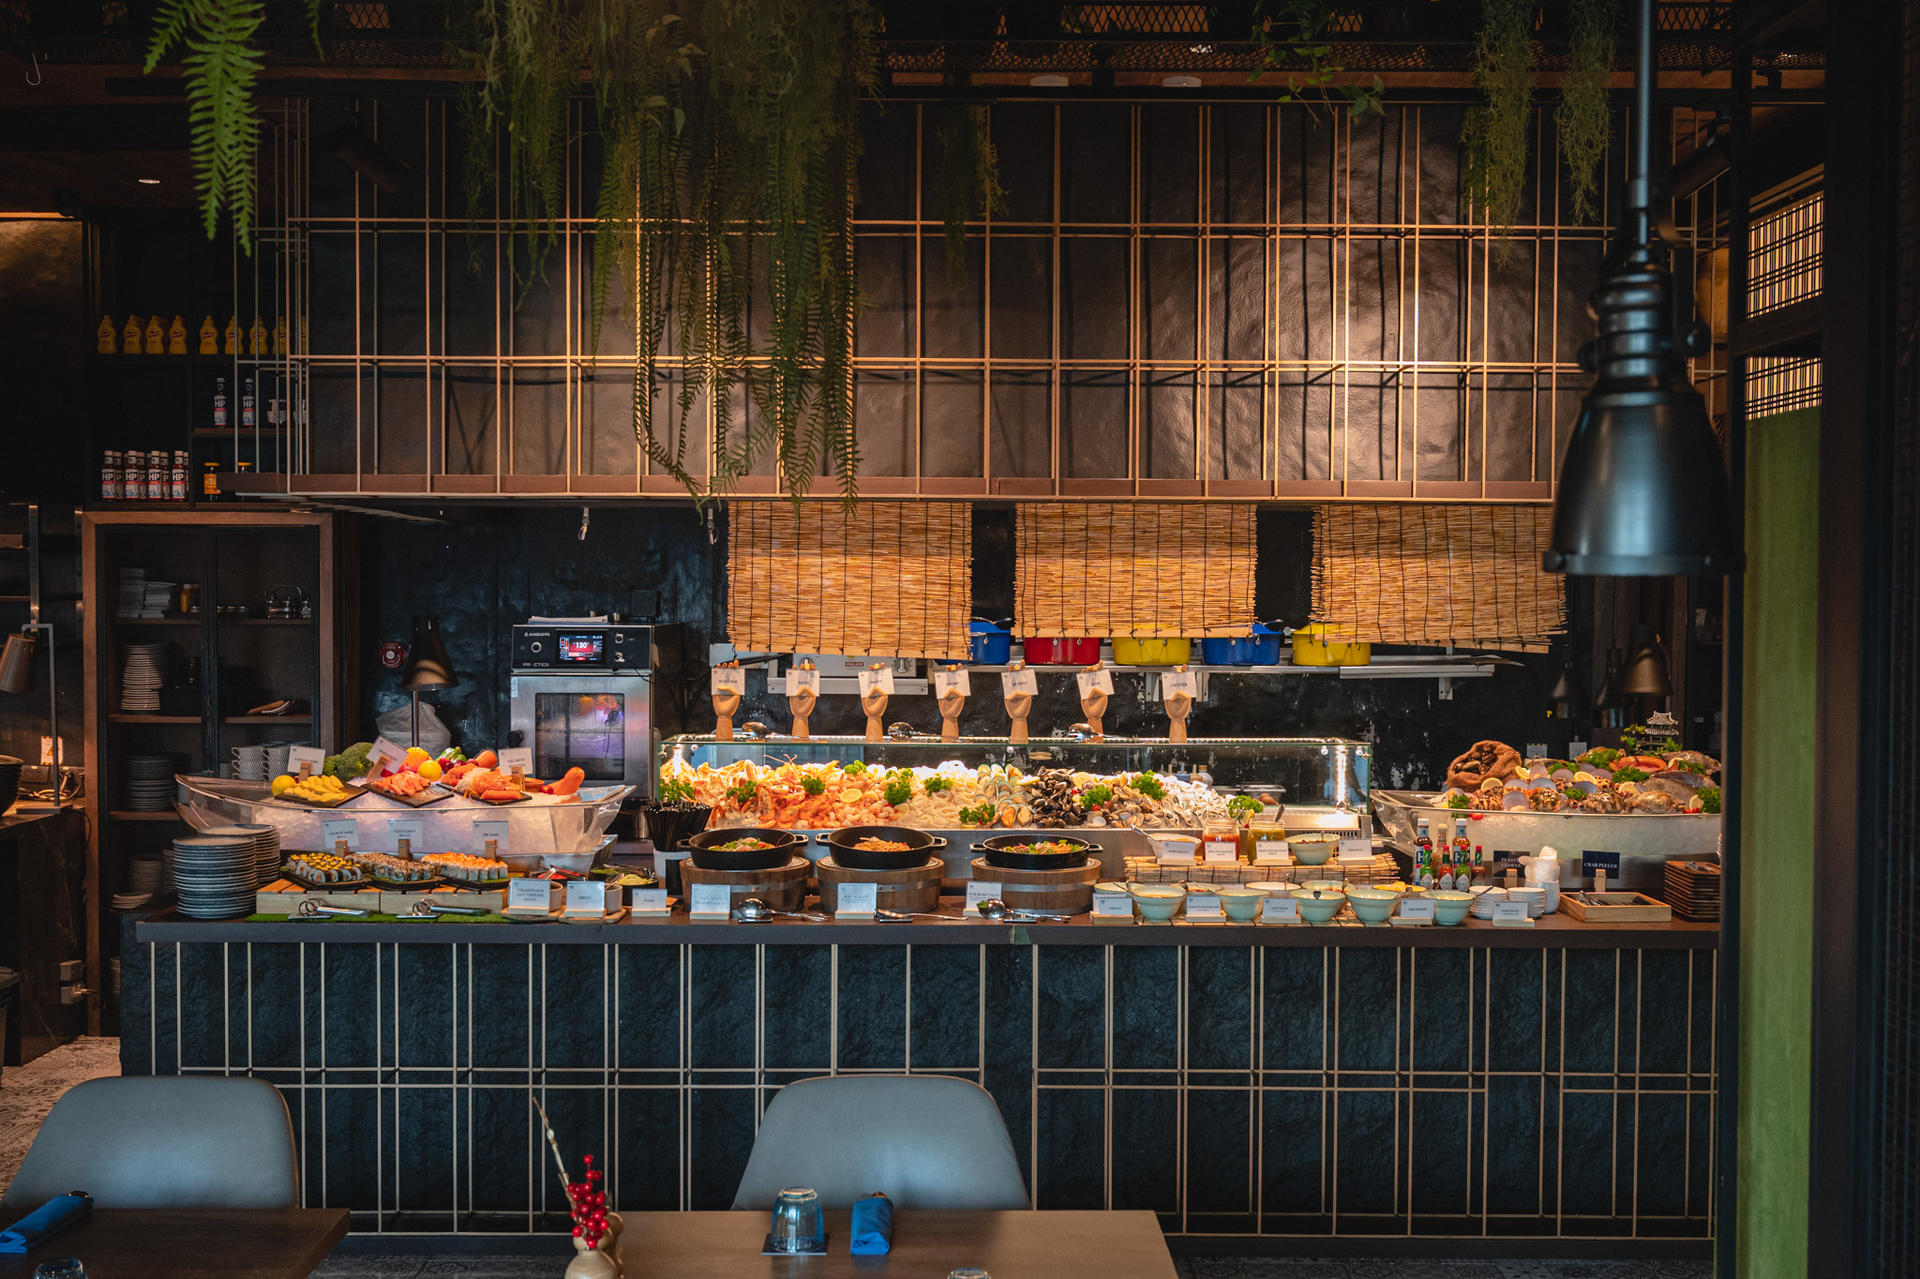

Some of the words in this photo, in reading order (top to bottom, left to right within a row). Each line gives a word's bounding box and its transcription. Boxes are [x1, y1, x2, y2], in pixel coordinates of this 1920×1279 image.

[214, 400, 226, 408] HP
[243, 400, 255, 408] HP
[102, 473, 114, 481] HP
[125, 473, 137, 481] HP
[148, 473, 160, 481] HP
[172, 473, 184, 481] HP
